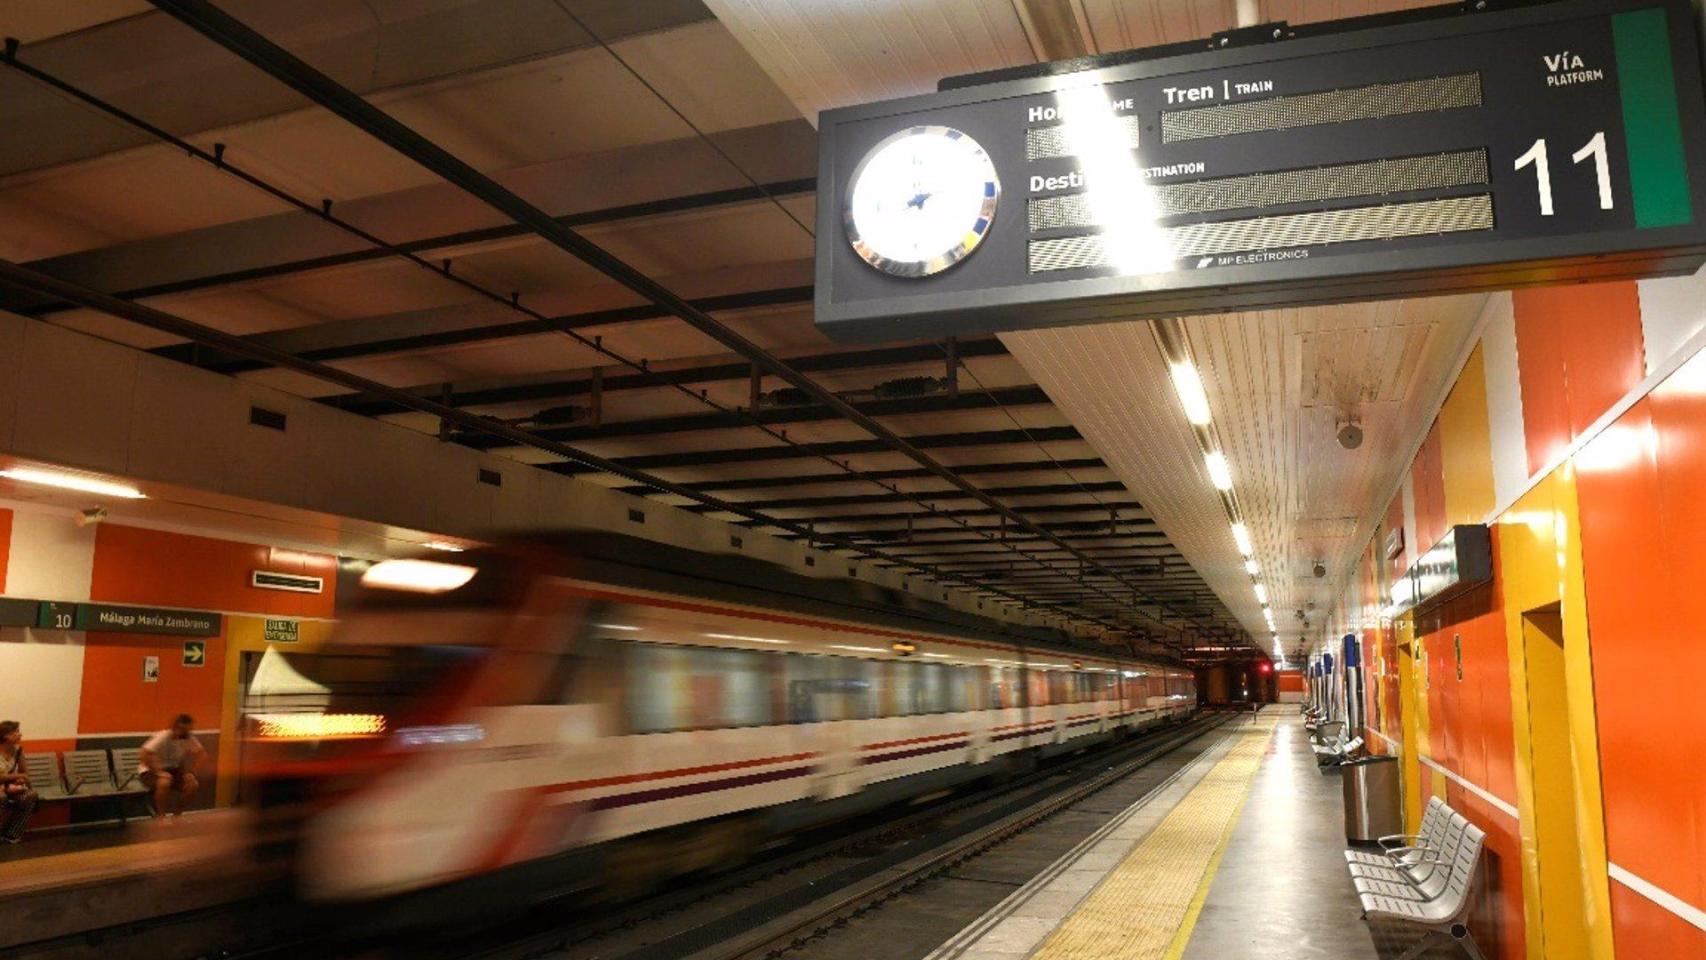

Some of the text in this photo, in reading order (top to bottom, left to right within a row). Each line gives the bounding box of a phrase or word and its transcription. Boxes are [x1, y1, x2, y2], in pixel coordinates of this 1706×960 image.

[1547, 69, 1603, 87] PLATFORM
[1163, 80, 1273, 104] Tren TRAIN
[1030, 172, 1085, 192] Desti
[1514, 131, 1614, 216] 11
[1236, 249, 1309, 265] ELECTRONICS
[55, 614, 72, 629] 10
[99, 612, 135, 625] Málaga
[138, 615, 164, 626] María
